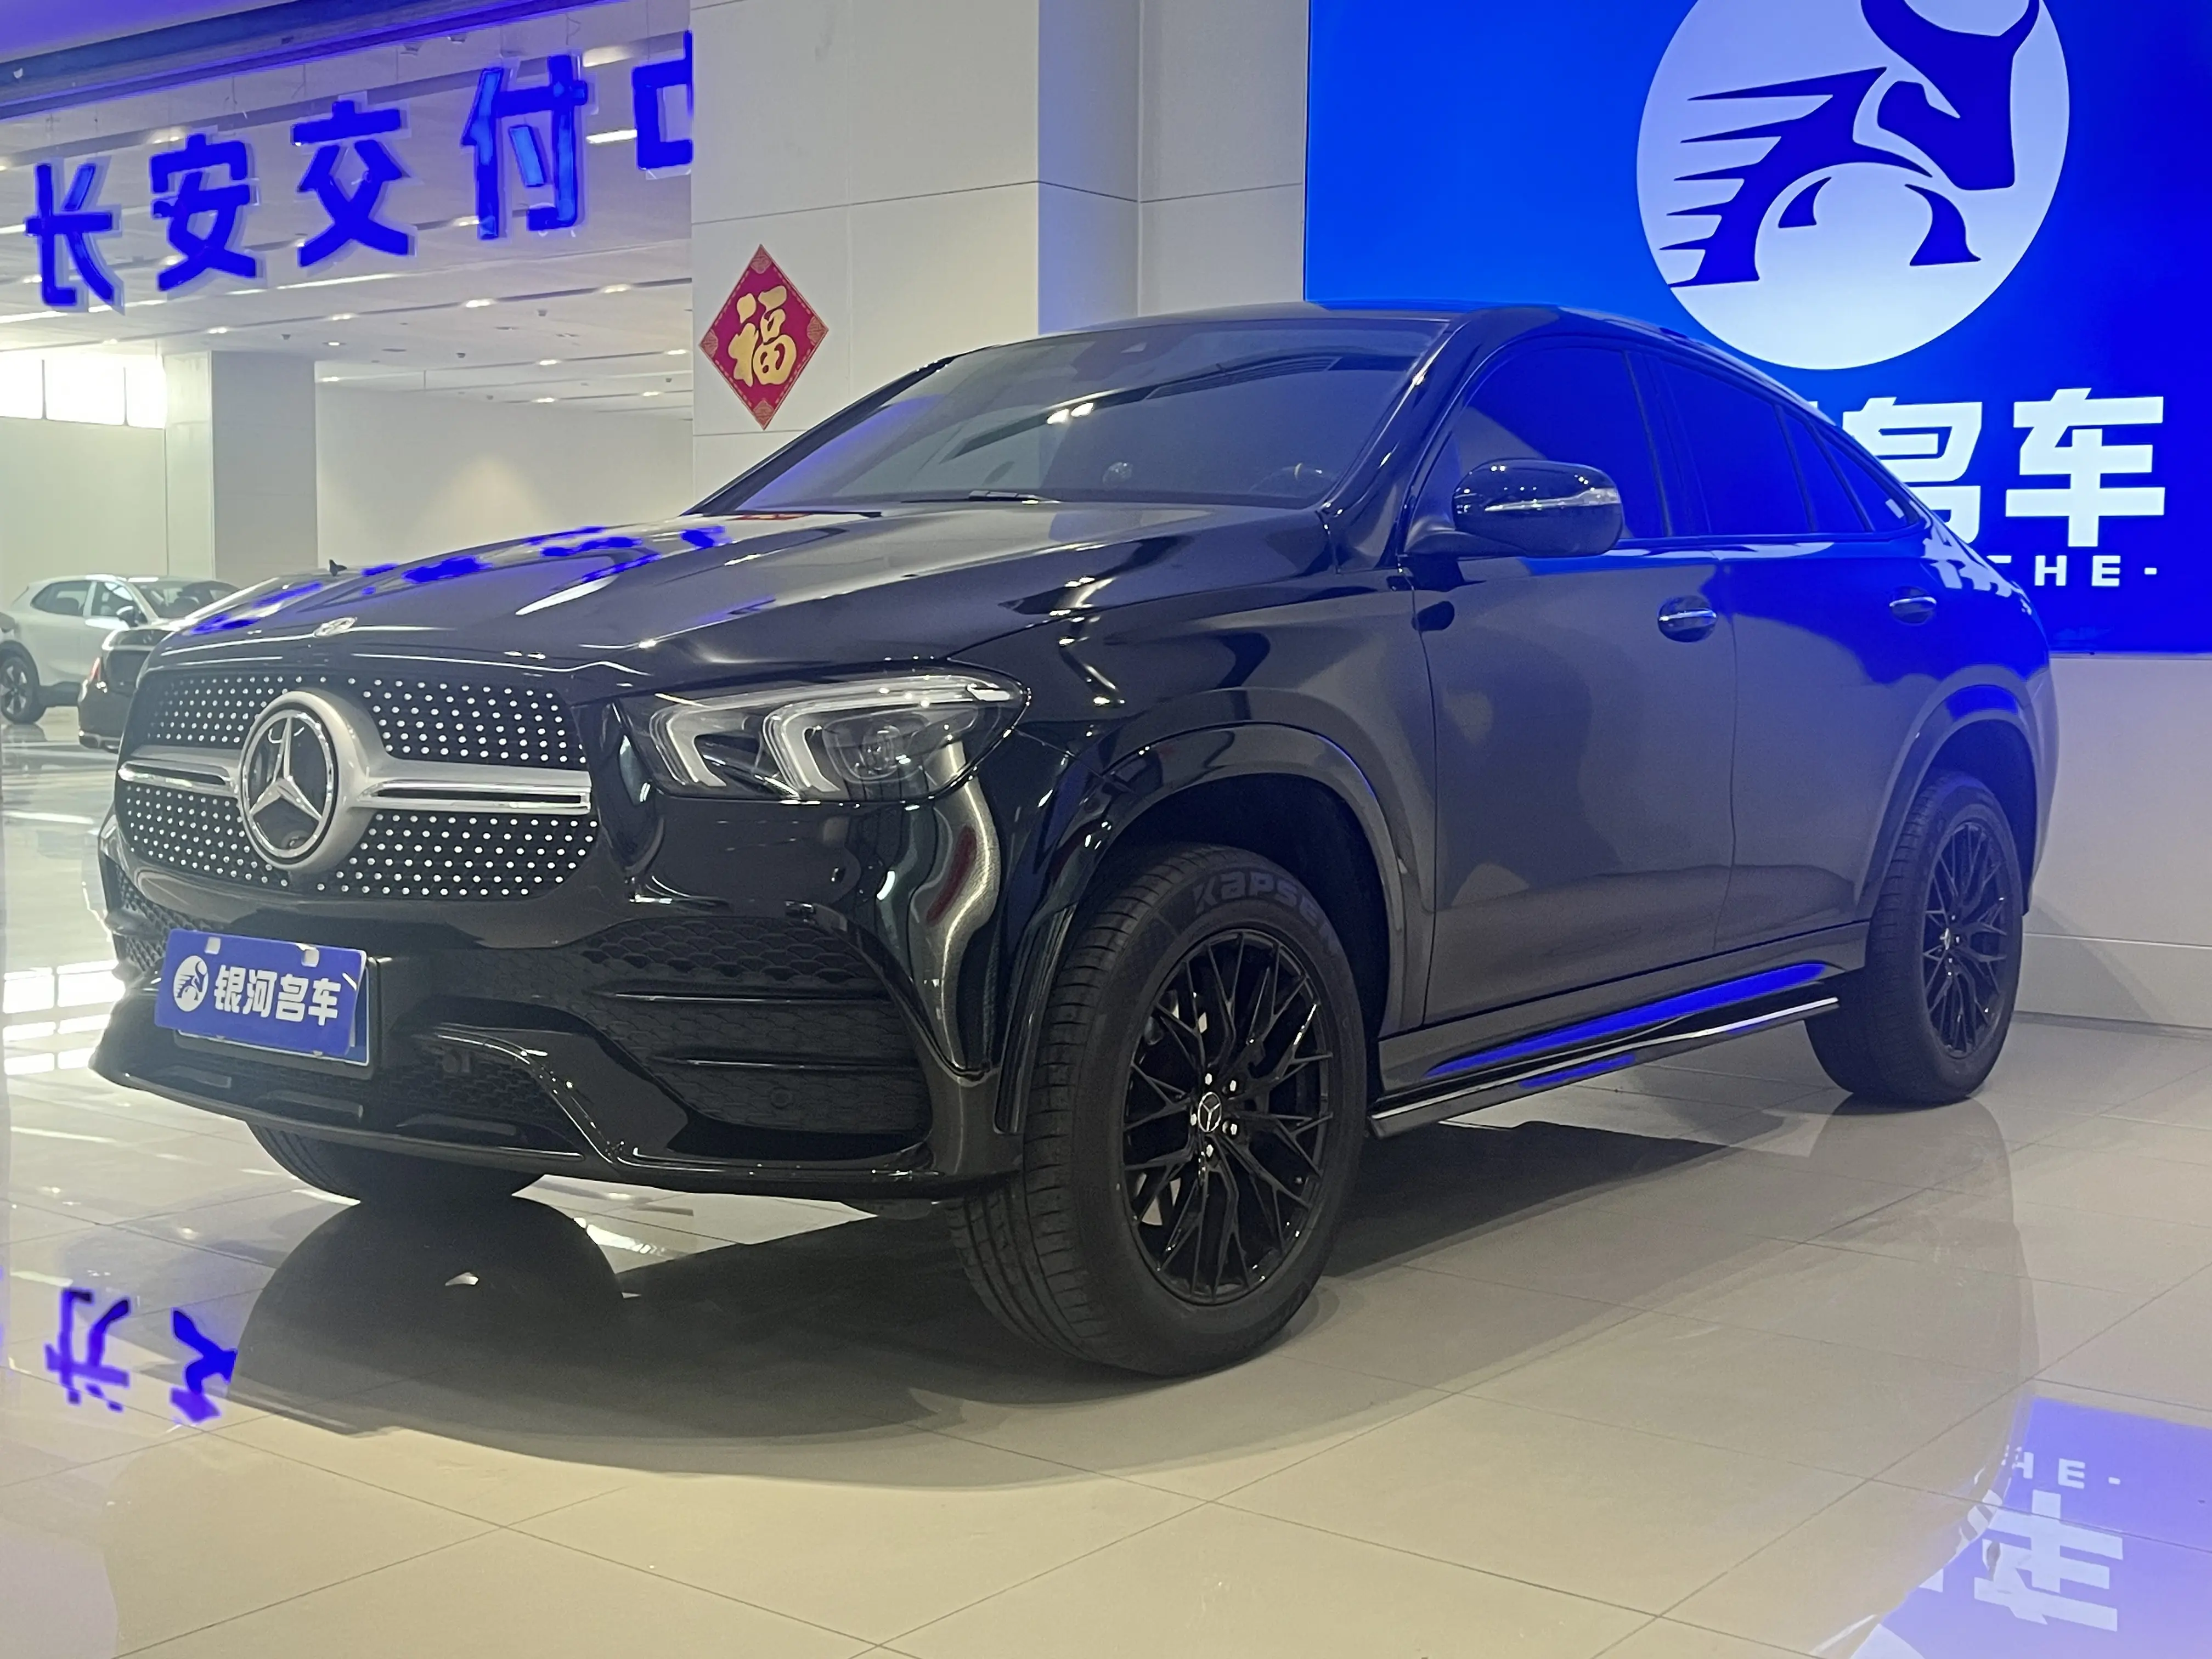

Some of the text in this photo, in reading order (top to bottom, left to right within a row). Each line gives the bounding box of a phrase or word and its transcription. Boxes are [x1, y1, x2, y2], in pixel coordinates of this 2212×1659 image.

[728, 285, 797, 387] 福
[1809, 387, 2165, 547] 名车
[213, 964, 341, 1026] 银河名车
